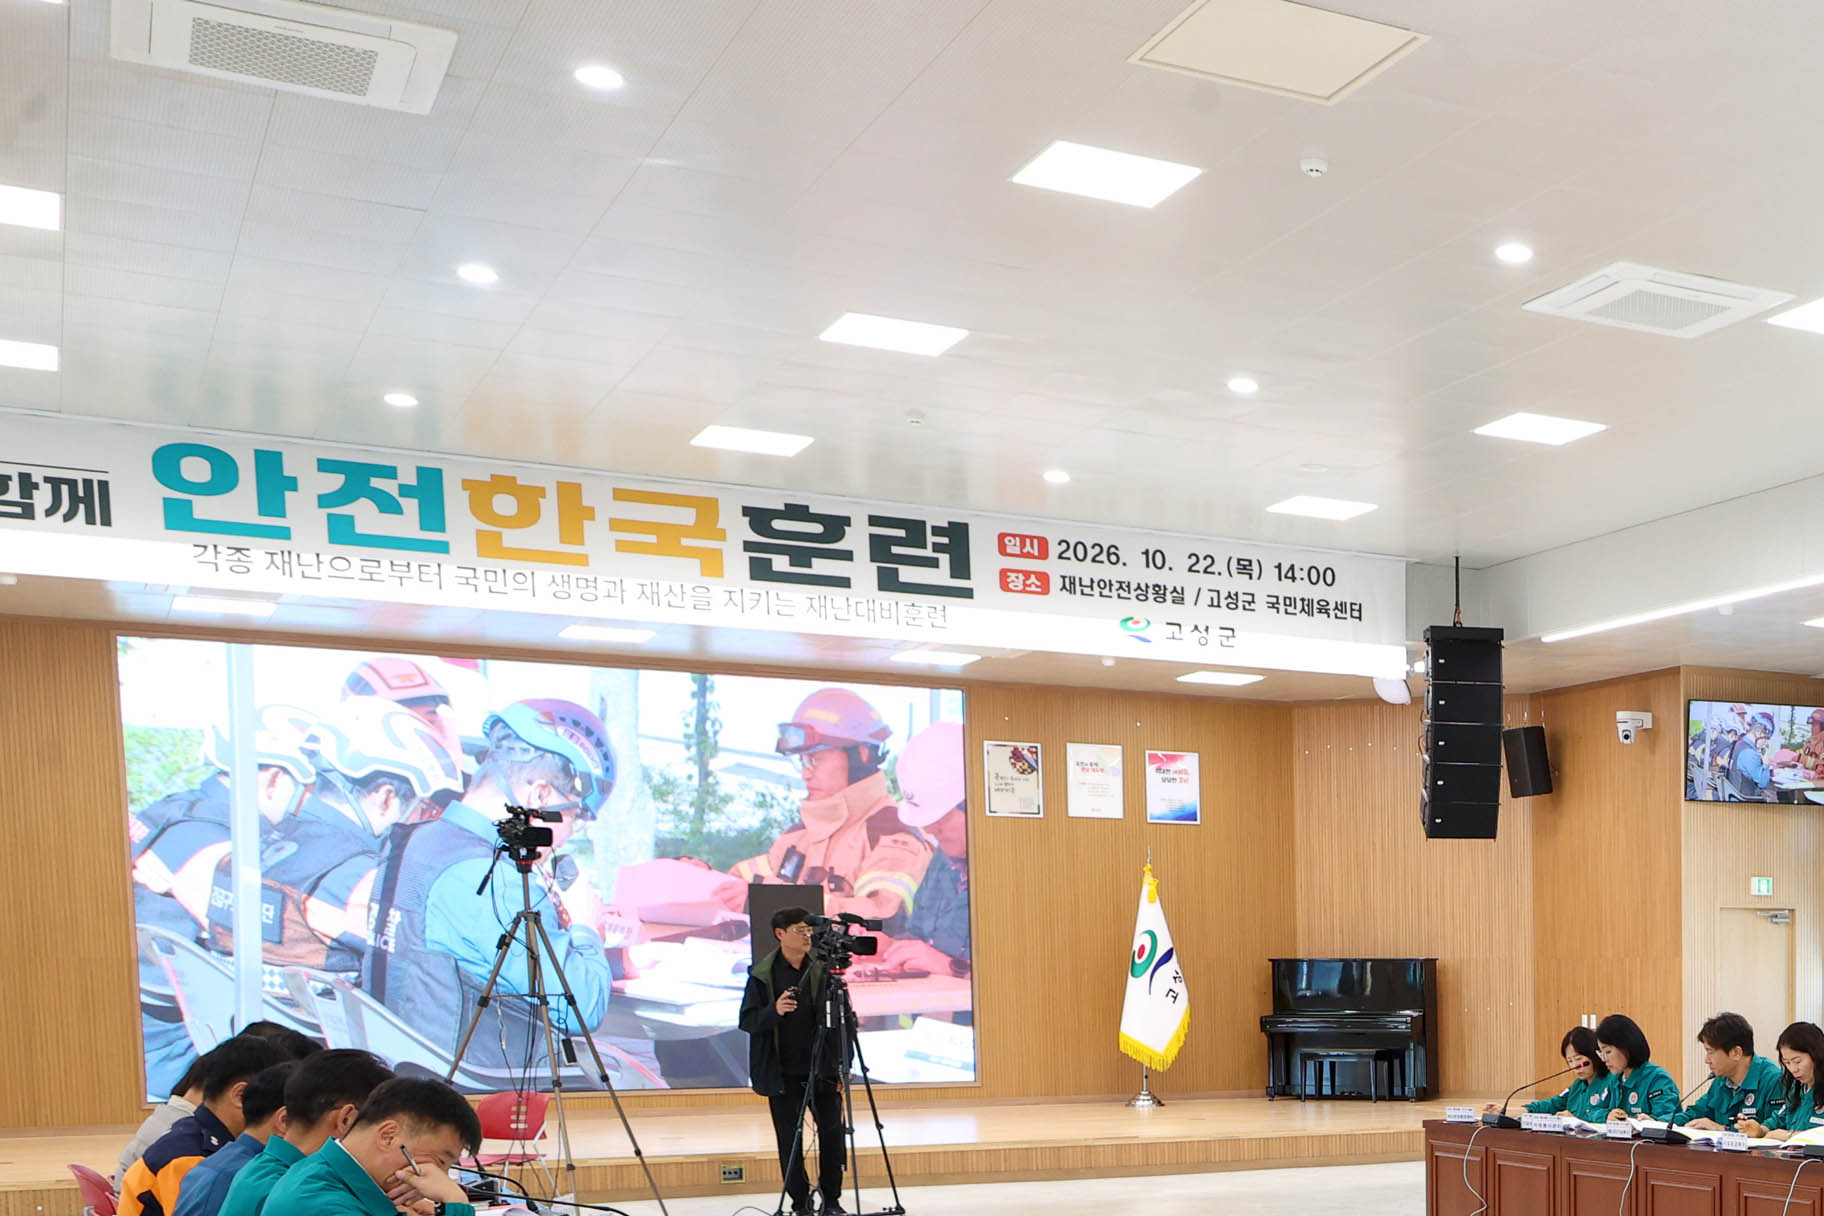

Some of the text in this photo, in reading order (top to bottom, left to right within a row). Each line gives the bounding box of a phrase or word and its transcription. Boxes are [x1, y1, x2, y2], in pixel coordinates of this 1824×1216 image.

[152, 442, 974, 599] 안전한국훈련
[191, 543, 949, 630] 각종 재난으로부터 국민의 생명과 재산을 지키는 재난대비훈련
[1004, 536, 1336, 587] 일시 2026. 10. 22.(목) 14:00
[1006, 573, 1042, 593] 장소
[1059, 575, 1185, 606] 재난안전상황실
[1207, 588, 1256, 612] 고성군
[1266, 594, 1362, 622] 국민체육센터
[1166, 622, 1236, 648] 고성군
